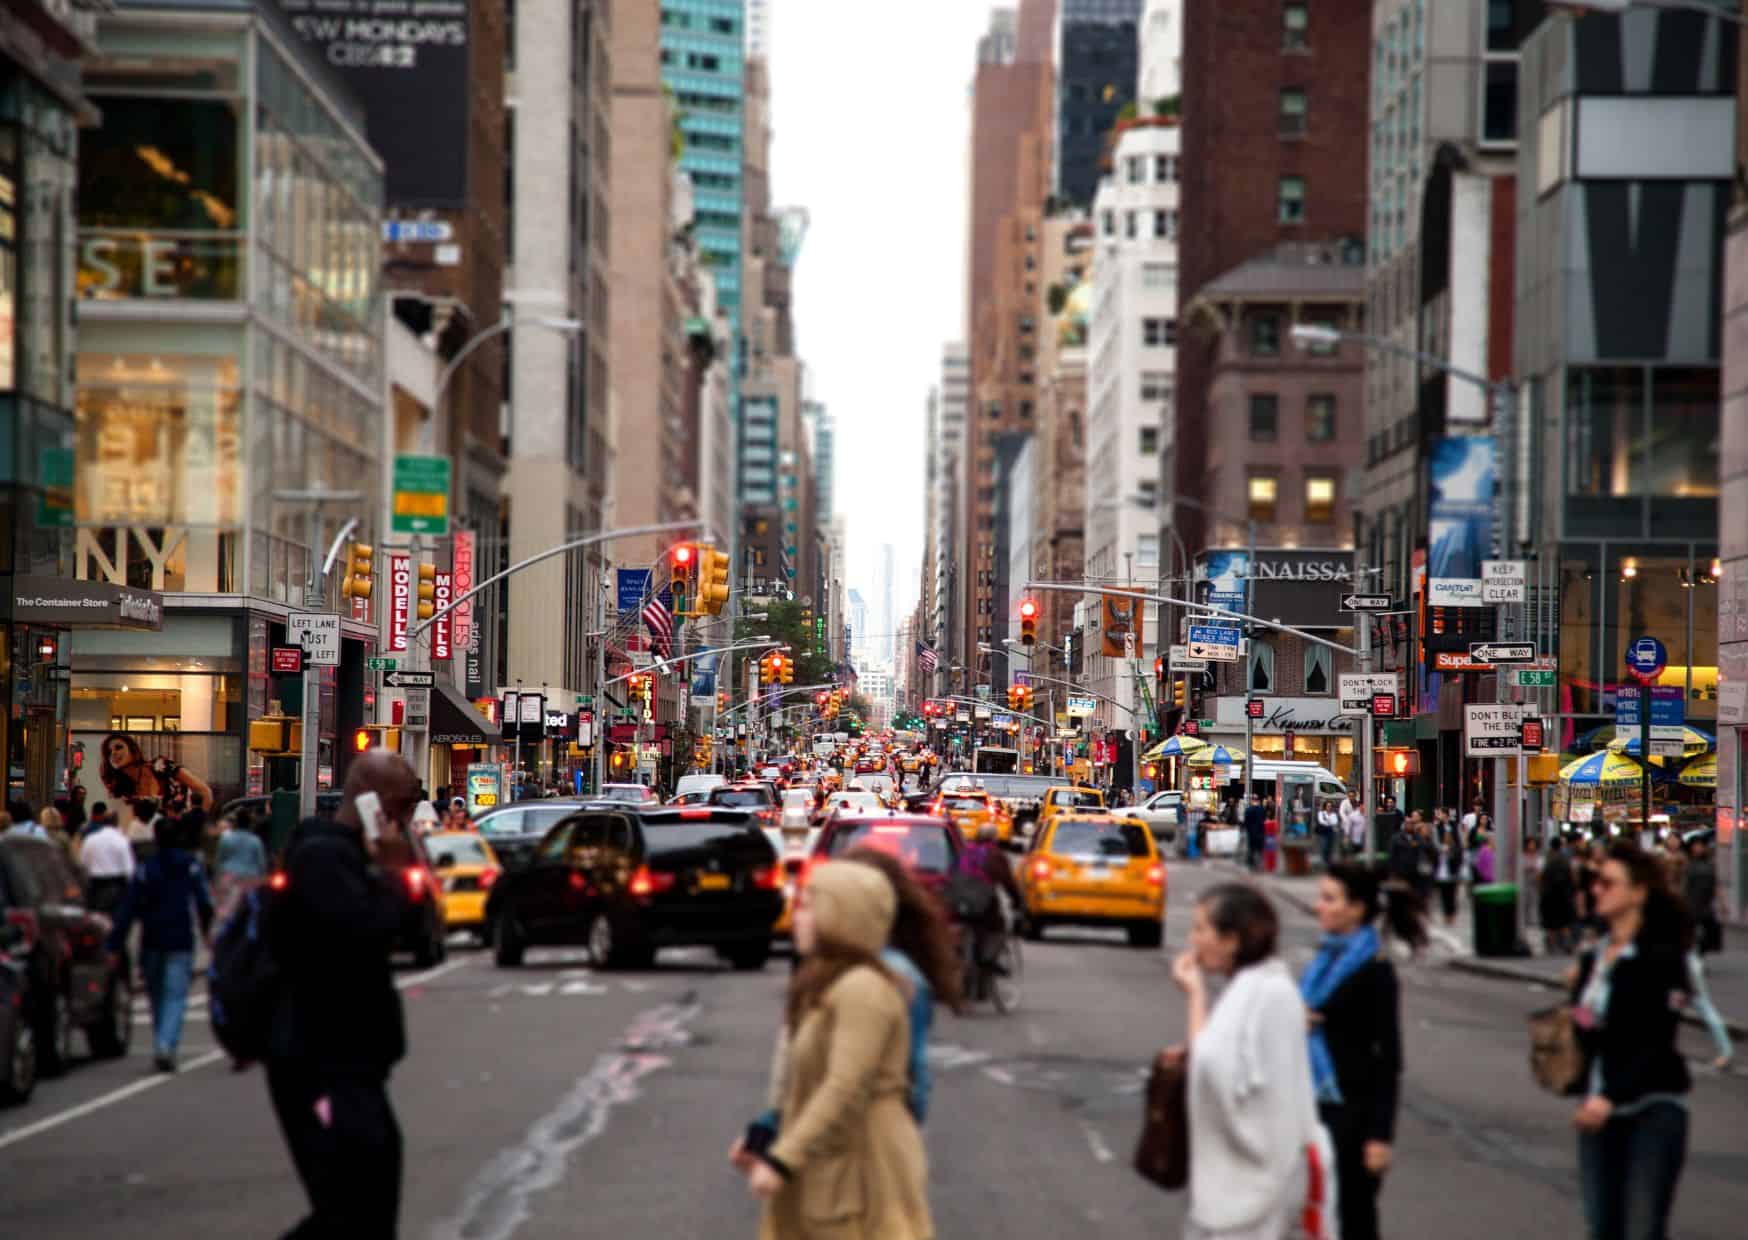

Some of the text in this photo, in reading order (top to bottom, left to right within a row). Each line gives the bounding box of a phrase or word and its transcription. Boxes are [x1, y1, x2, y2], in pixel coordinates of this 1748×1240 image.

[1491, 563, 1516, 574] KEEP
[1489, 588, 1519, 599] CLEAR
[16, 597, 109, 608] The Container Store
[292, 619, 337, 629] LEFT LANE
[316, 650, 336, 659] LEFT
[1477, 648, 1530, 658] ONE WAY
[467, 658, 481, 683] nail
[1521, 674, 1527, 684] E
[1530, 673, 1542, 684] 58
[1483, 722, 1502, 731] THE
[432, 735, 481, 743] AEROSOLES
